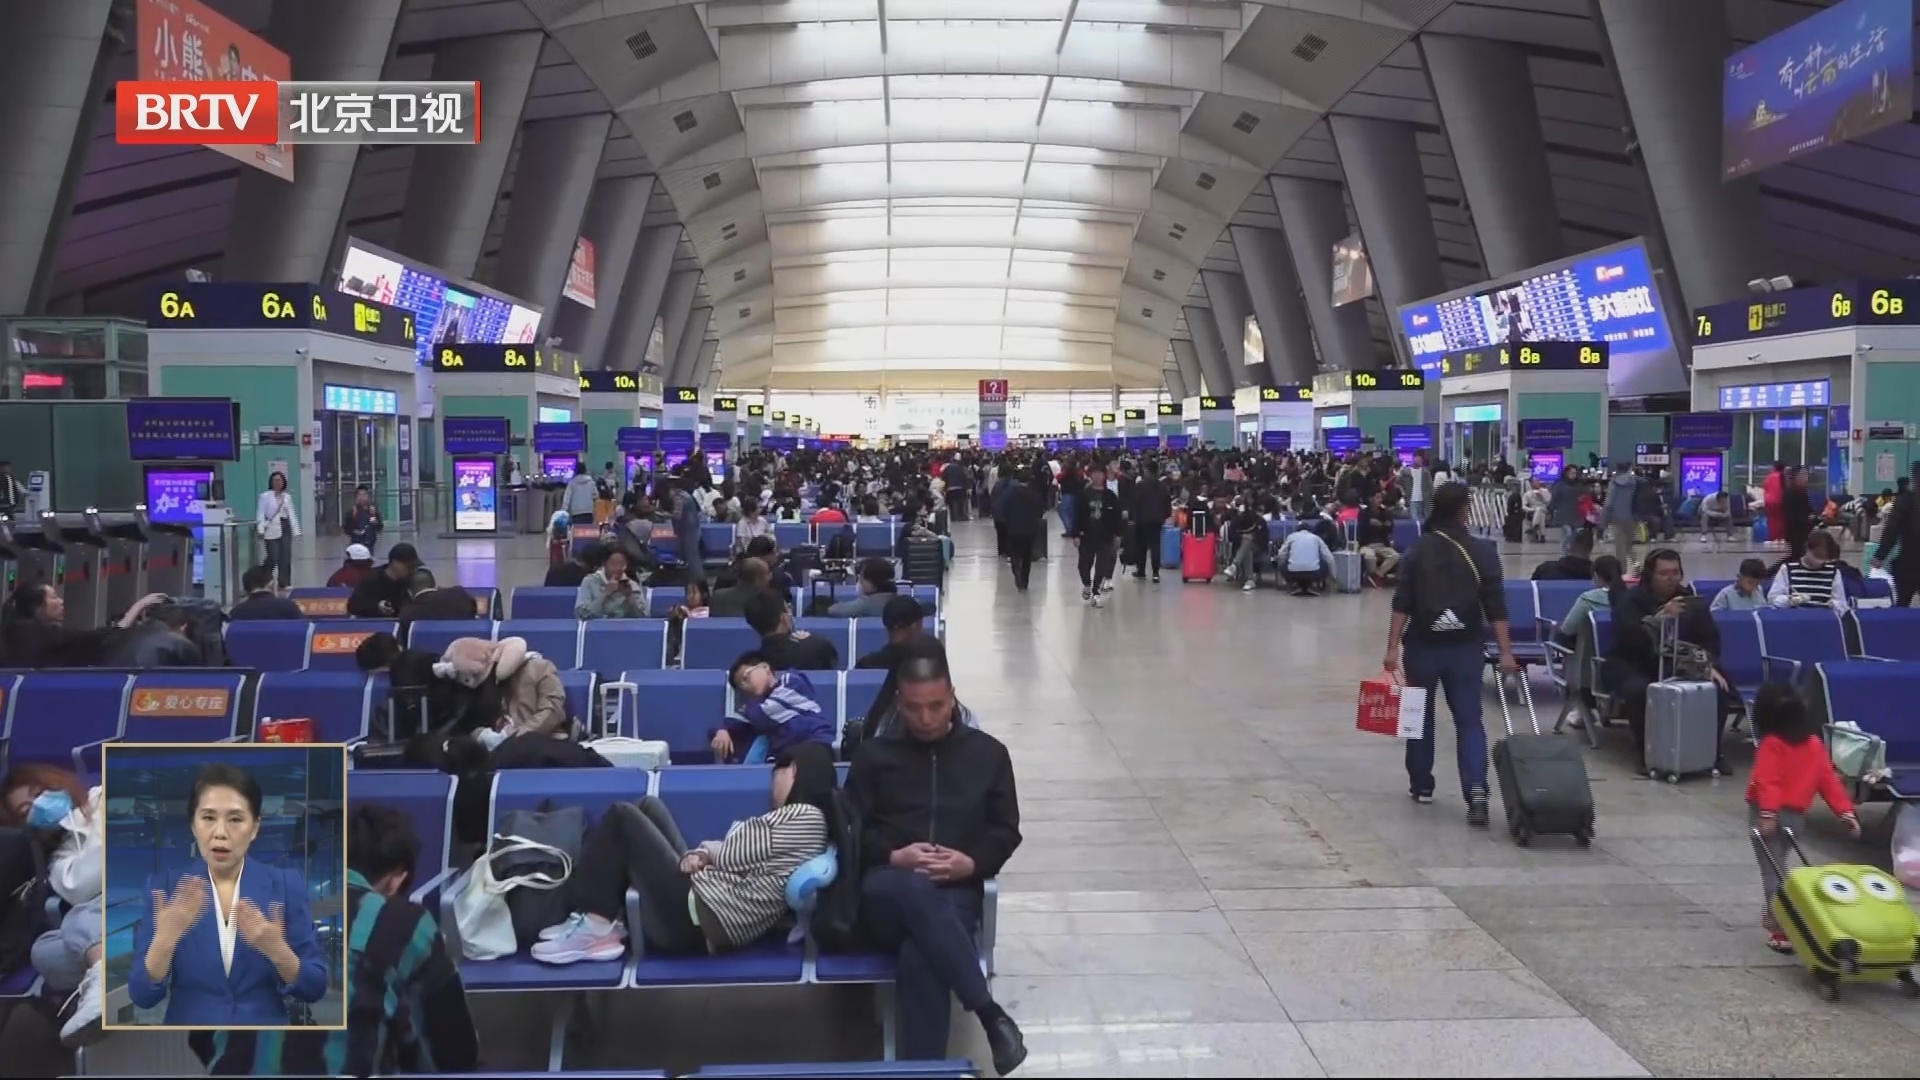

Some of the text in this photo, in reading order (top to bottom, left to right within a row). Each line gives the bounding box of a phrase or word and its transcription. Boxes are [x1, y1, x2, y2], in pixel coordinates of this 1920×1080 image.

[160, 292, 195, 318] 6A
[261, 292, 296, 318] 6A
[312, 295, 327, 320] 6A
[1831, 292, 1851, 318] 6B
[1871, 290, 1903, 315] 6B
[1697, 315, 1711, 336] 7B
[441, 349, 464, 366] 8A
[504, 349, 526, 366] 8A
[1519, 346, 1540, 365] 8B
[1579, 346, 1600, 365] 8B
[614, 376, 635, 388] 10A
[1355, 374, 1376, 387] 10B
[1400, 374, 1421, 386] 10B
[678, 390, 696, 401] 12A
[339, 636, 362, 648] 爱心
[164, 694, 224, 710] 爱心专座
